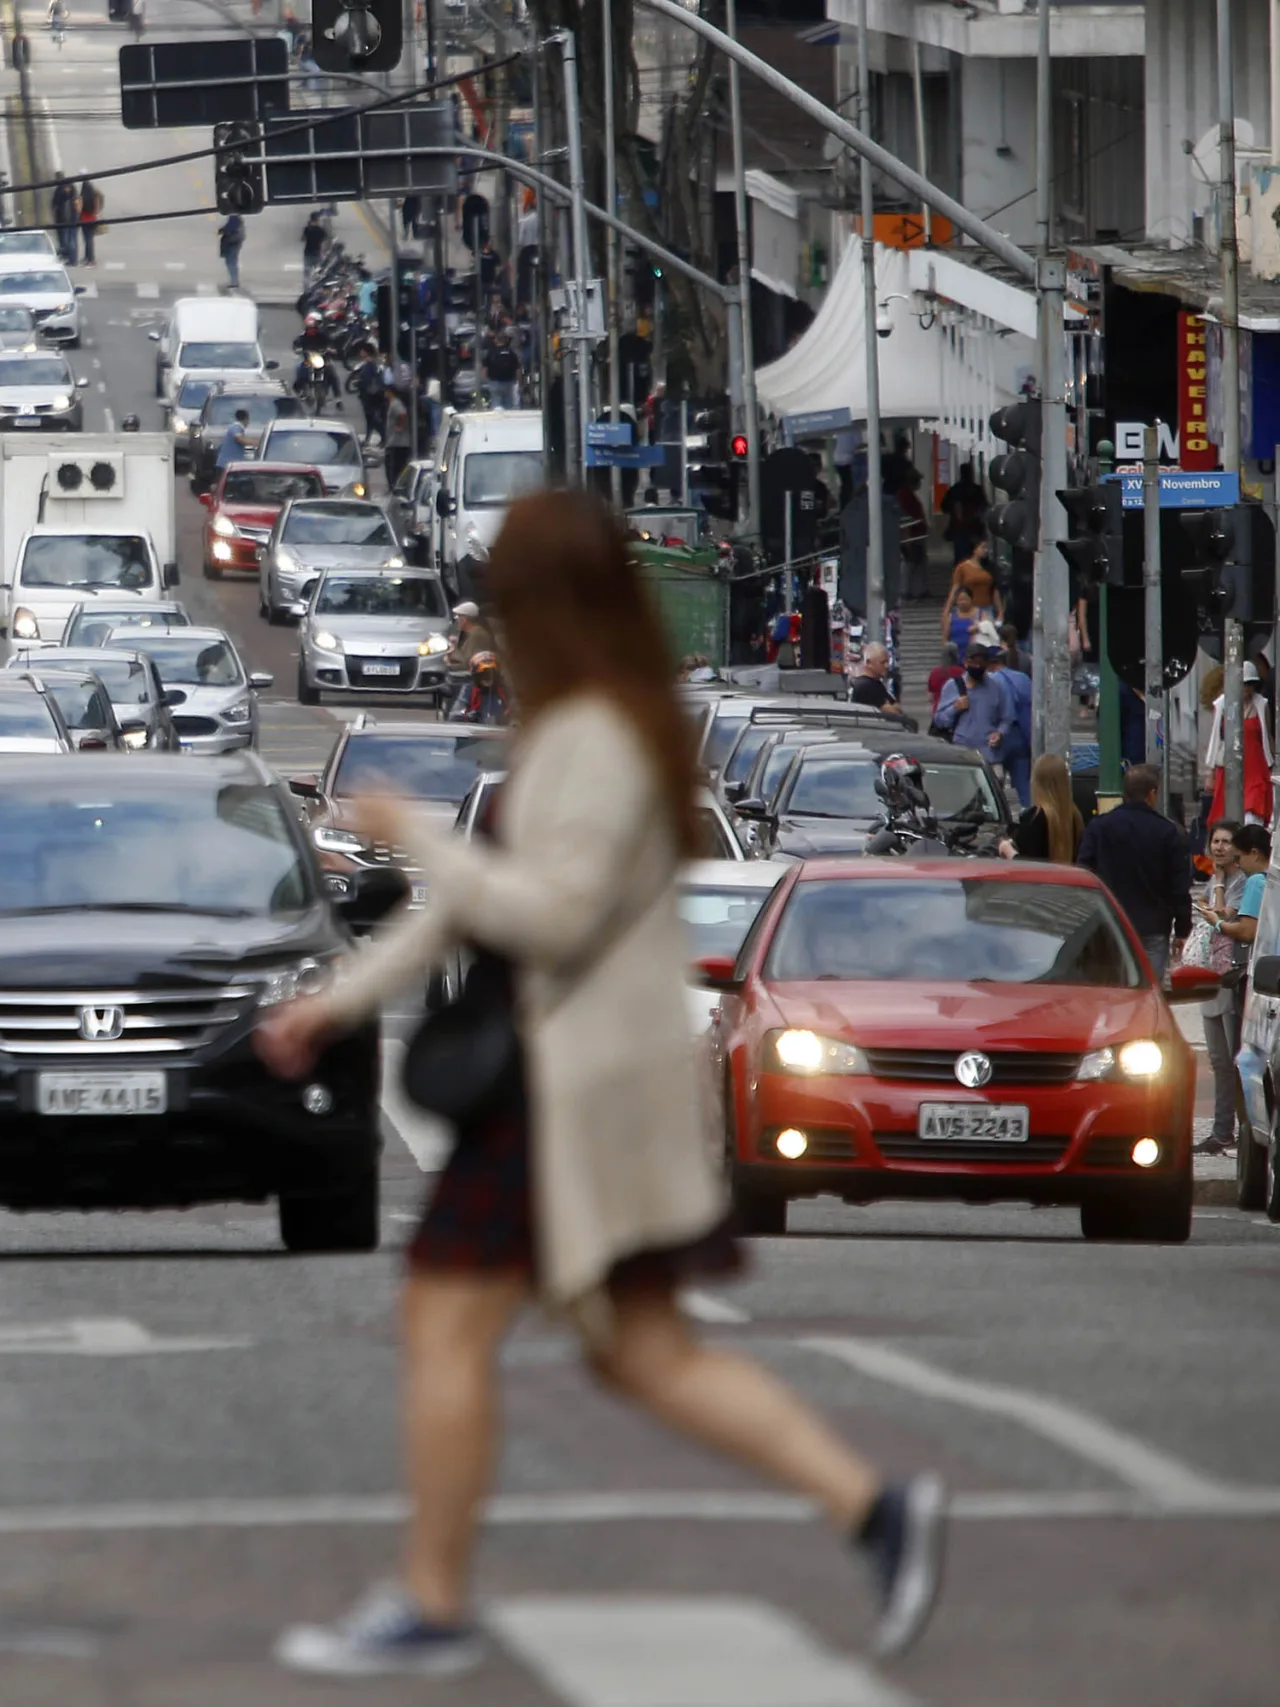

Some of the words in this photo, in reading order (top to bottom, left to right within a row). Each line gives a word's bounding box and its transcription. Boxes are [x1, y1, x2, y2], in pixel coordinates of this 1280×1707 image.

[1186, 315, 1209, 451] CHAVEIRO
[1162, 479, 1221, 490] Novembro
[924, 1117, 1024, 1138] AVS-2243
